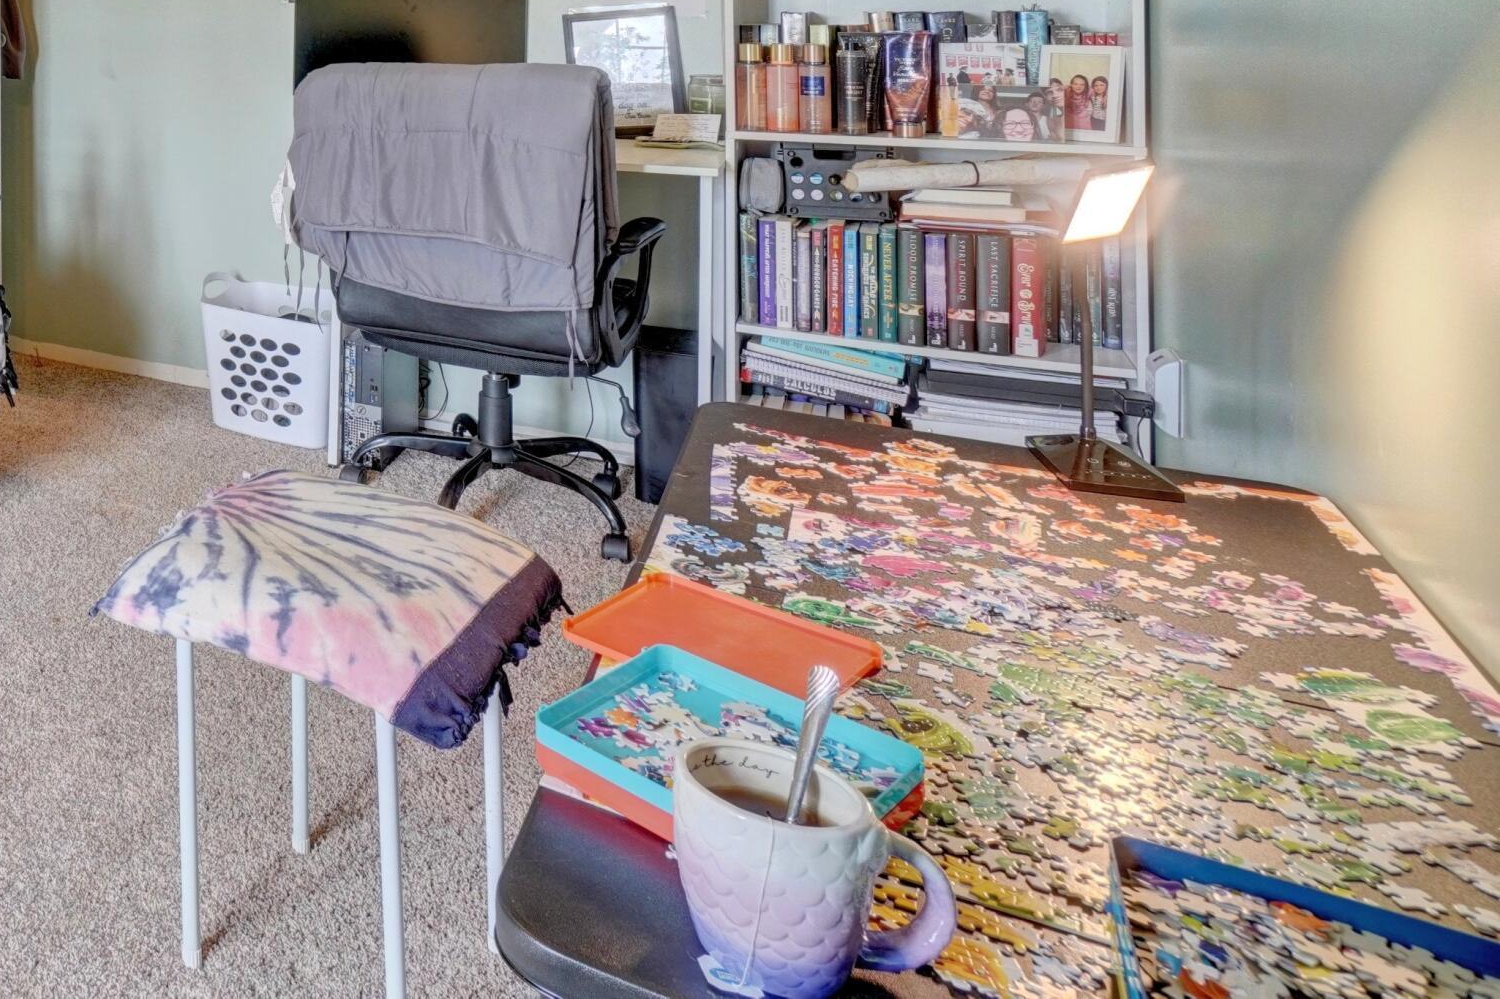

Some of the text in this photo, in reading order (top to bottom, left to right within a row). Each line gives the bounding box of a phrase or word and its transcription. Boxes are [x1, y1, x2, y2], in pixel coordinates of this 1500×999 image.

[883, 242, 892, 300] NEVER AFTER
[909, 235, 917, 301] BLOOD PROMISE
[958, 240, 966, 301] SPIRIT BOUND
[784, 373, 836, 397] CALCULUS
[703, 754, 733, 768] the
[738, 756, 780, 779] day
